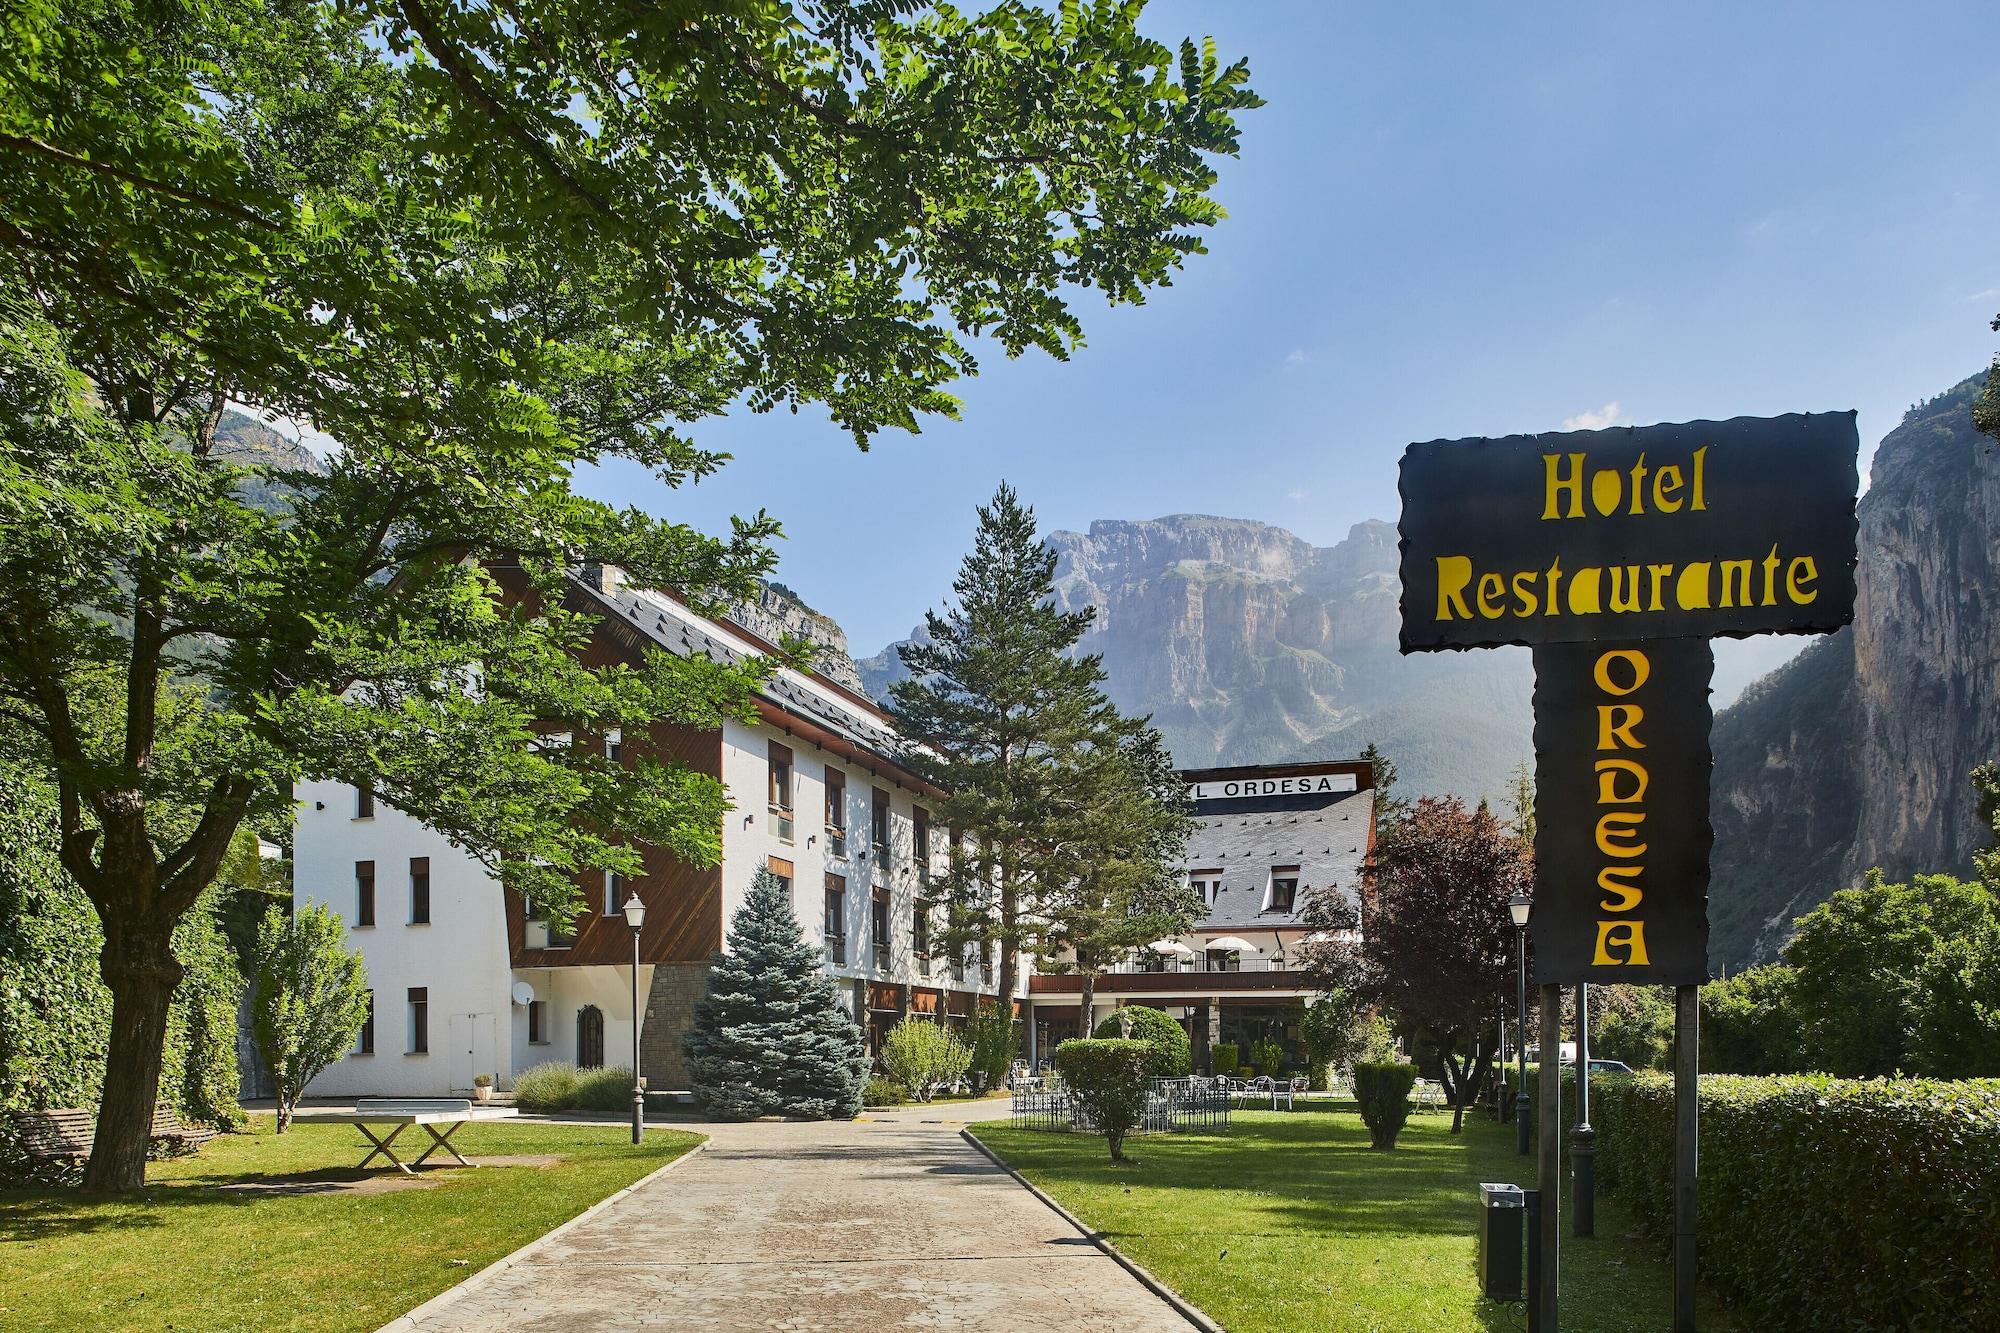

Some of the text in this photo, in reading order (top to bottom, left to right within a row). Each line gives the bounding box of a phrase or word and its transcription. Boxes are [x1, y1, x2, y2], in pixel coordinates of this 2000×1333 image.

[1541, 445, 1707, 520] Hotel
[1435, 543, 1819, 621] Restaurante
[1224, 777, 1332, 797] ORDESA
[1592, 649, 1651, 966] ORDESA
